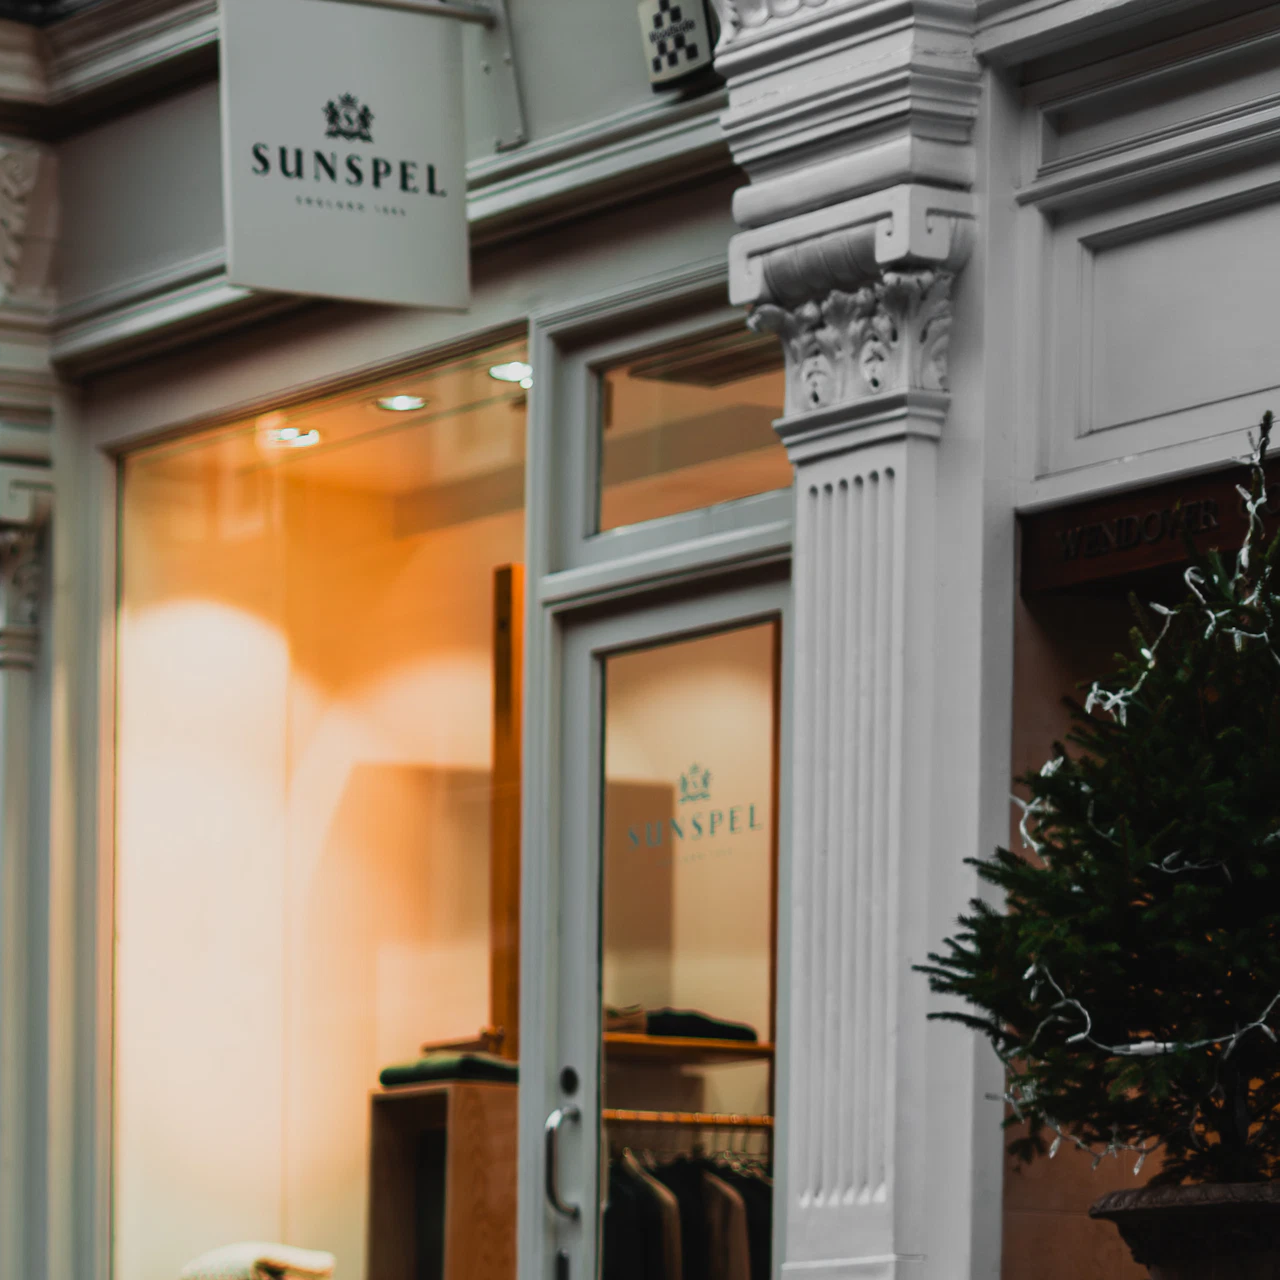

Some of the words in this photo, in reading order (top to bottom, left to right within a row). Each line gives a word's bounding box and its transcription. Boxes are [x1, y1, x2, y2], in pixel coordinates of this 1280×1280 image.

[251, 142, 448, 198] SUNSPEL
[1057, 498, 1219, 562] WENDOVER
[627, 803, 764, 852] SUNSPEL
